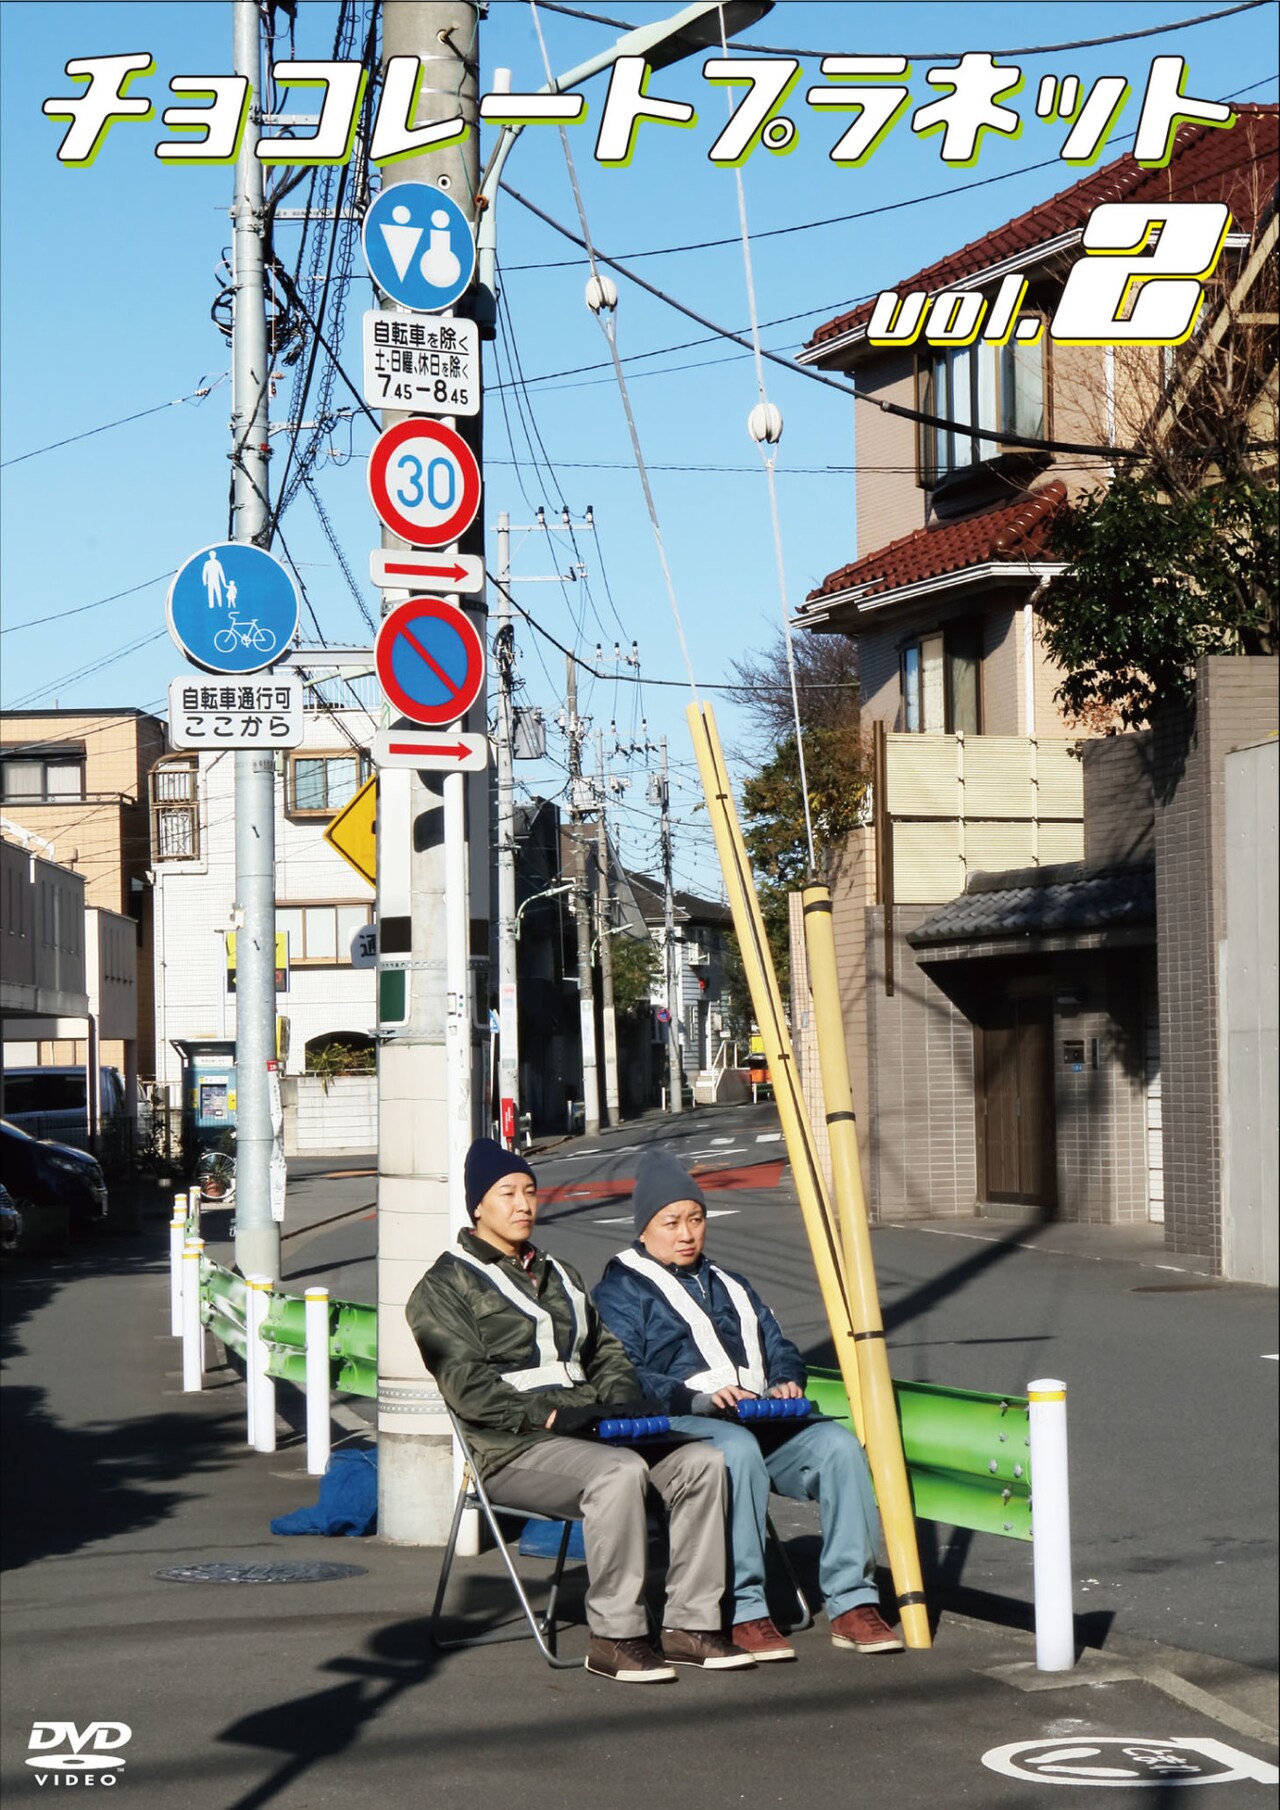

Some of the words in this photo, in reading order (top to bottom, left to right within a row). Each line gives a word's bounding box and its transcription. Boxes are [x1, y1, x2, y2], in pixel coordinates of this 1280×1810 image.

[374, 320, 468, 352] 自転車を除く
[397, 454, 455, 510] 30
[183, 686, 291, 710] 自転車通行可
[185, 716, 290, 737] ここから
